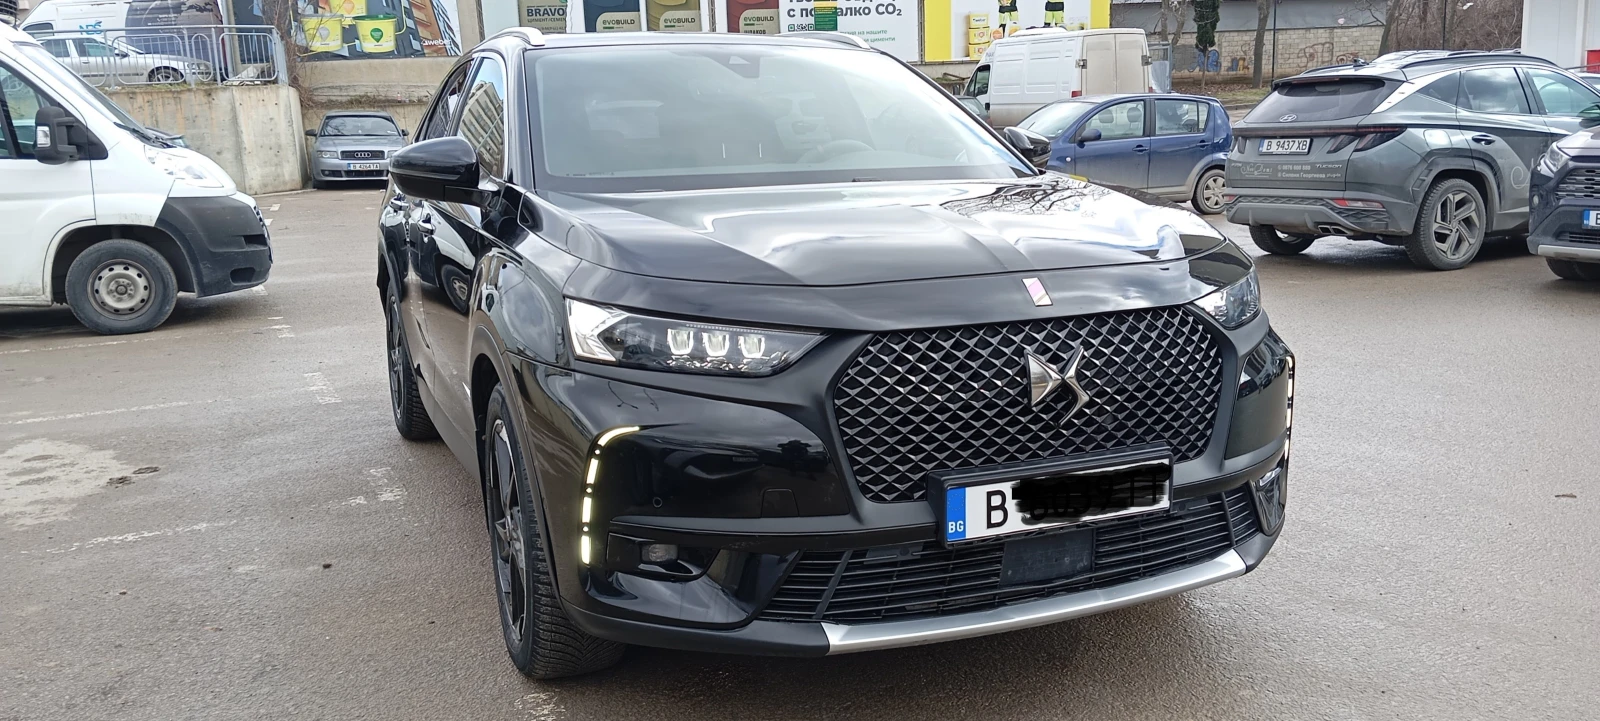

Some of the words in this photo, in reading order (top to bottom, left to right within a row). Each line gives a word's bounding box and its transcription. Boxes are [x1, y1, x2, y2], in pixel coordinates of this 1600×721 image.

[527, 8, 565, 17] BRAVO
[787, 8, 796, 18] с
[1266, 141, 1272, 150] B
[1276, 140, 1294, 150] 9437
[1296, 139, 1308, 150] XB
[986, 490, 1009, 530] B
[948, 521, 964, 533] BG
